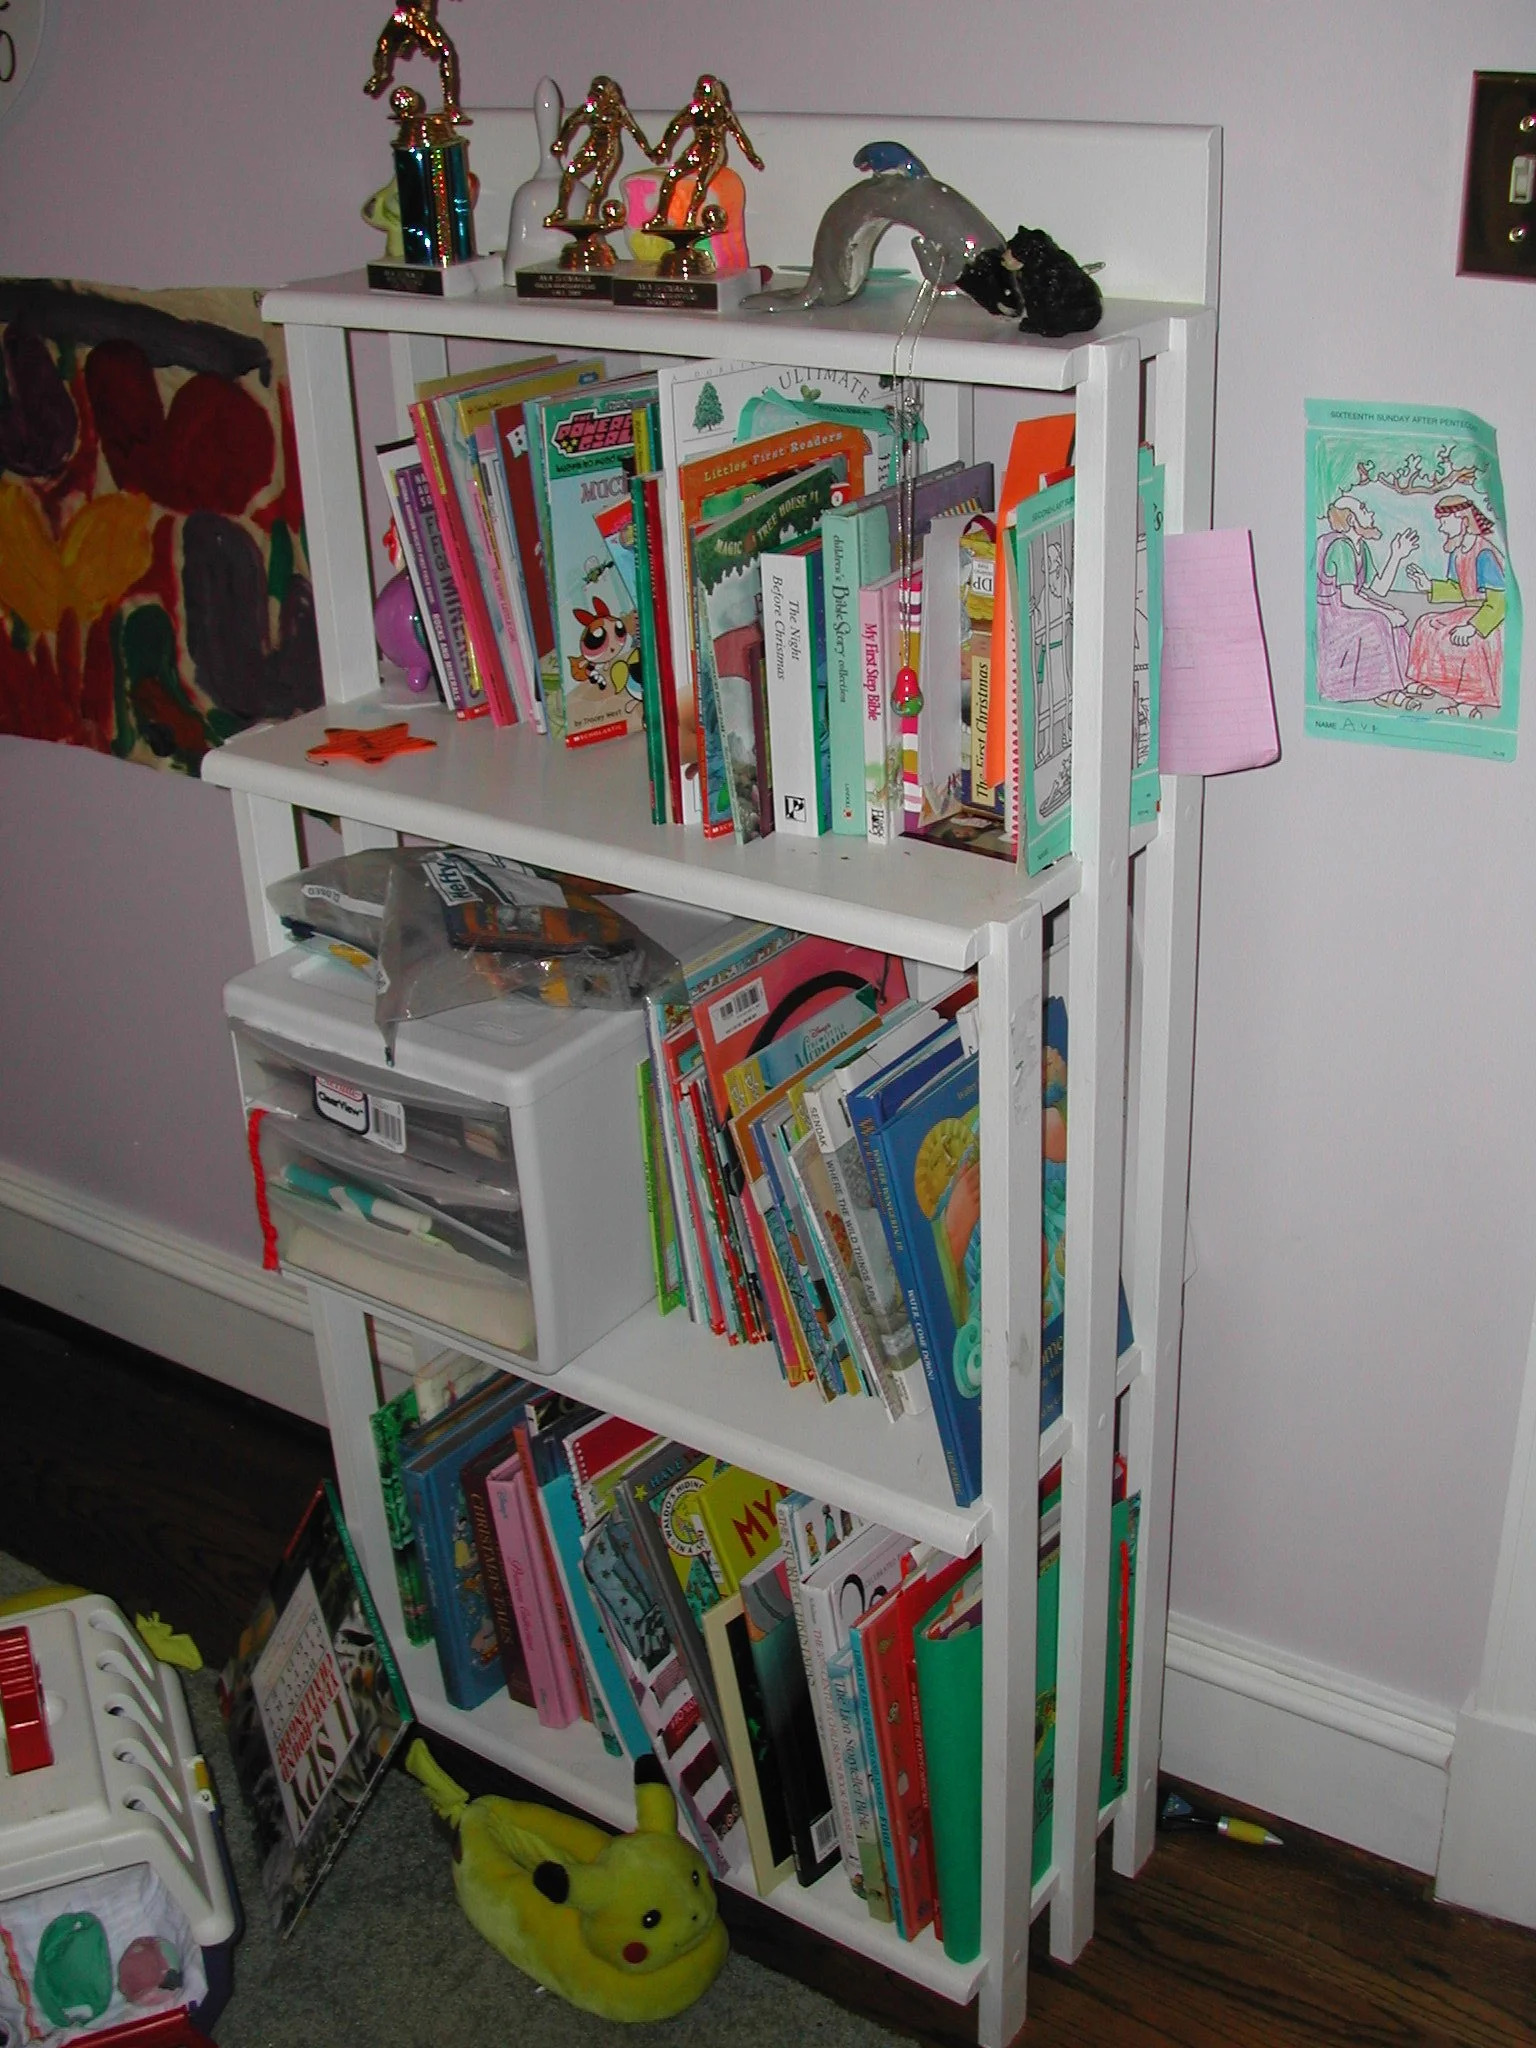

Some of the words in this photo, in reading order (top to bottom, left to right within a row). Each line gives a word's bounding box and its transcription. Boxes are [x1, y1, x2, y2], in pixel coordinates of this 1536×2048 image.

[778, 368, 873, 404] ULTIMATE
[556, 414, 633, 440] POWERP
[1330, 411, 1374, 421] SIXTEENTH
[1376, 414, 1410, 423] SUNDAY
[1412, 416, 1438, 425] AFTER
[578, 429, 633, 451] GIRL
[704, 462, 748, 482] Littles
[752, 448, 787, 466] First
[790, 431, 843, 454] Readers
[714, 538, 744, 556] MAGIC
[756, 512, 780, 541] TREE
[779, 494, 809, 518] HOUSE
[833, 534, 845, 581] children's
[770, 575, 784, 618] Before
[788, 600, 800, 623] The
[832, 585, 850, 622] Bible
[431, 612, 446, 641] ROCKS
[787, 626, 802, 661] Night
[833, 621, 852, 658] Story
[861, 623, 878, 643] My
[440, 642, 450, 661] AND
[774, 619, 786, 681] Christmas
[865, 643, 880, 669] First
[444, 660, 461, 701] MINERALS
[838, 660, 850, 703] collection
[864, 669, 880, 692] Step
[975, 661, 989, 734] Christmas
[867, 693, 882, 722] Bible
[1315, 720, 1337, 730] NAME
[437, 853, 473, 899] Hefty
[810, 1106, 828, 1147] SENDAK
[826, 1159, 844, 1197] WHERE
[838, 1199, 849, 1219] THE
[846, 1219, 858, 1244] WILD
[852, 1244, 871, 1285] THINGS
[866, 1283, 877, 1303] ARE
[915, 1321, 928, 1349] COME
[921, 1349, 936, 1382] DOWN!
[663, 1492, 676, 1539] WALDO'S
[732, 1489, 778, 1559] MY
[676, 1544, 685, 1552] IN
[468, 1491, 503, 1590] CHRISTMAS
[490, 1594, 514, 1646] TALES
[836, 1681, 847, 1705] The
[840, 1707, 852, 1733] Lion
[846, 1736, 865, 1797] Storyteller
[854, 1799, 869, 1831] Bible
